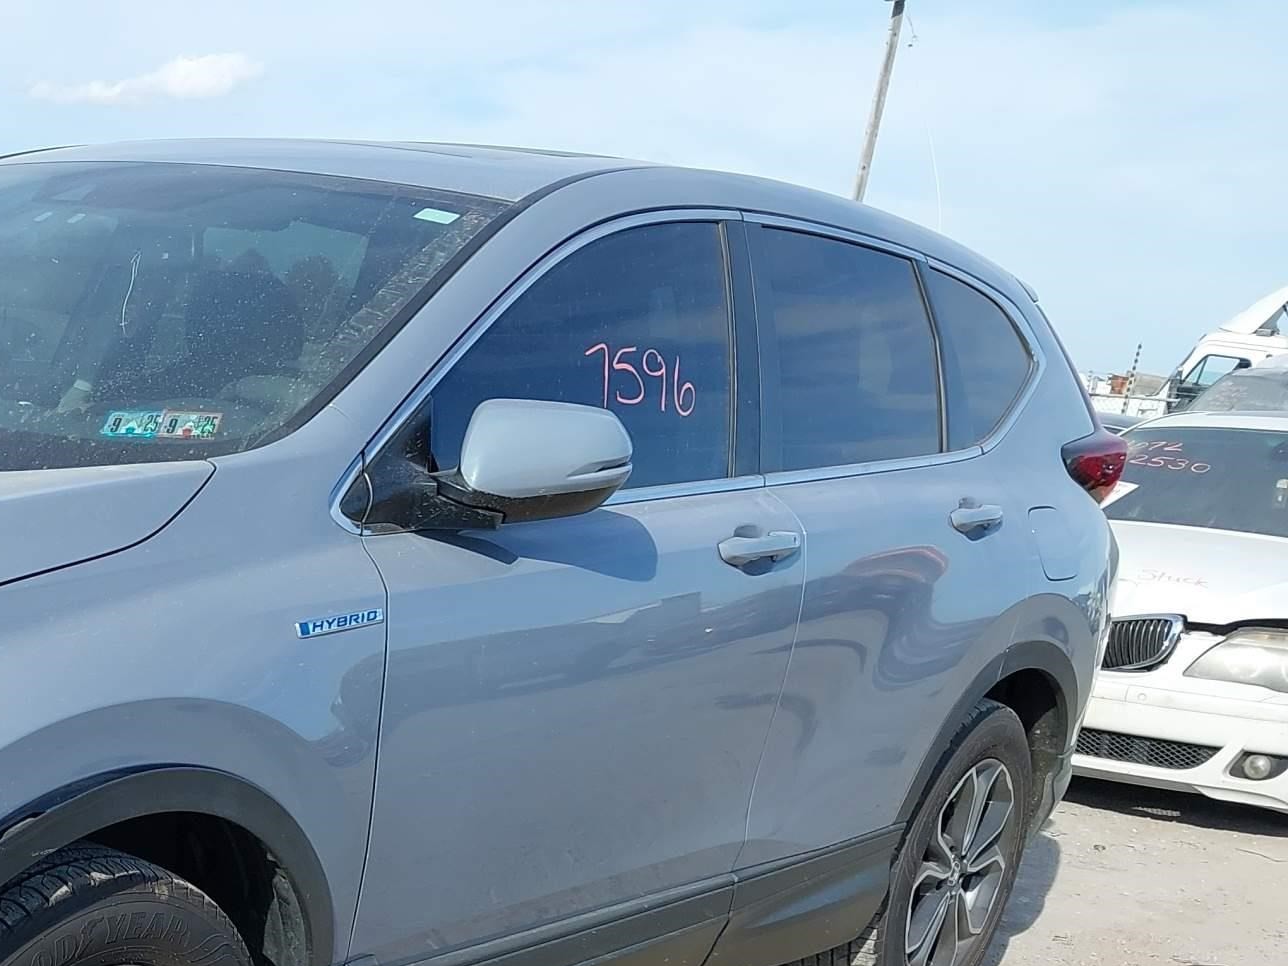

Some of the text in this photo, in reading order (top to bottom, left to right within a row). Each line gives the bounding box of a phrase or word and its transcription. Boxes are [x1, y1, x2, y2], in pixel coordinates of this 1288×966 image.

[584, 341, 696, 418] 7596
[110, 414, 161, 433] 9 25
[166, 416, 218, 434] 9 25
[1128, 454, 1212, 474] 2530
[311, 609, 379, 634] HYBRID
